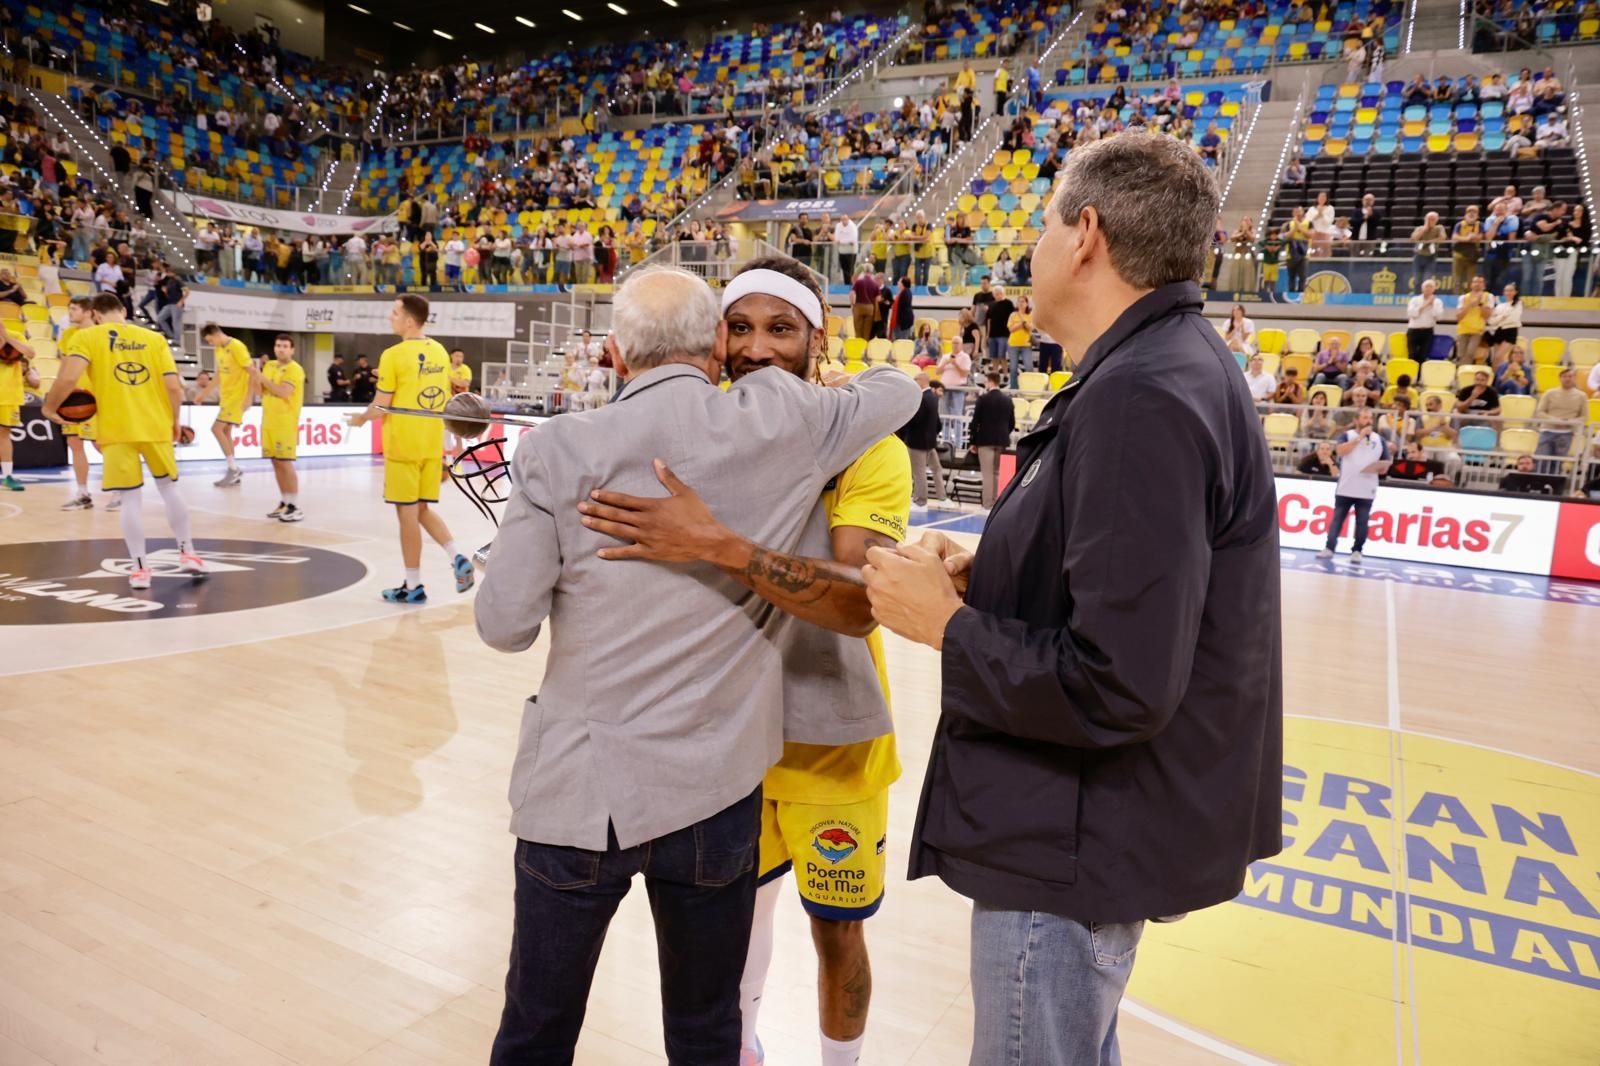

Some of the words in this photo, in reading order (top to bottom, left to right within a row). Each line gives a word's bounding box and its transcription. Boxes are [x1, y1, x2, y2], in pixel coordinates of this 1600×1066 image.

[305, 307, 334, 321] Hertz
[809, 820, 836, 835] DISCOVER
[838, 820, 861, 836] NATURE
[806, 862, 866, 880] Poema
[807, 878, 830, 892] del
[834, 880, 866, 894] Mar
[808, 892, 867, 904] AQUARIUM
